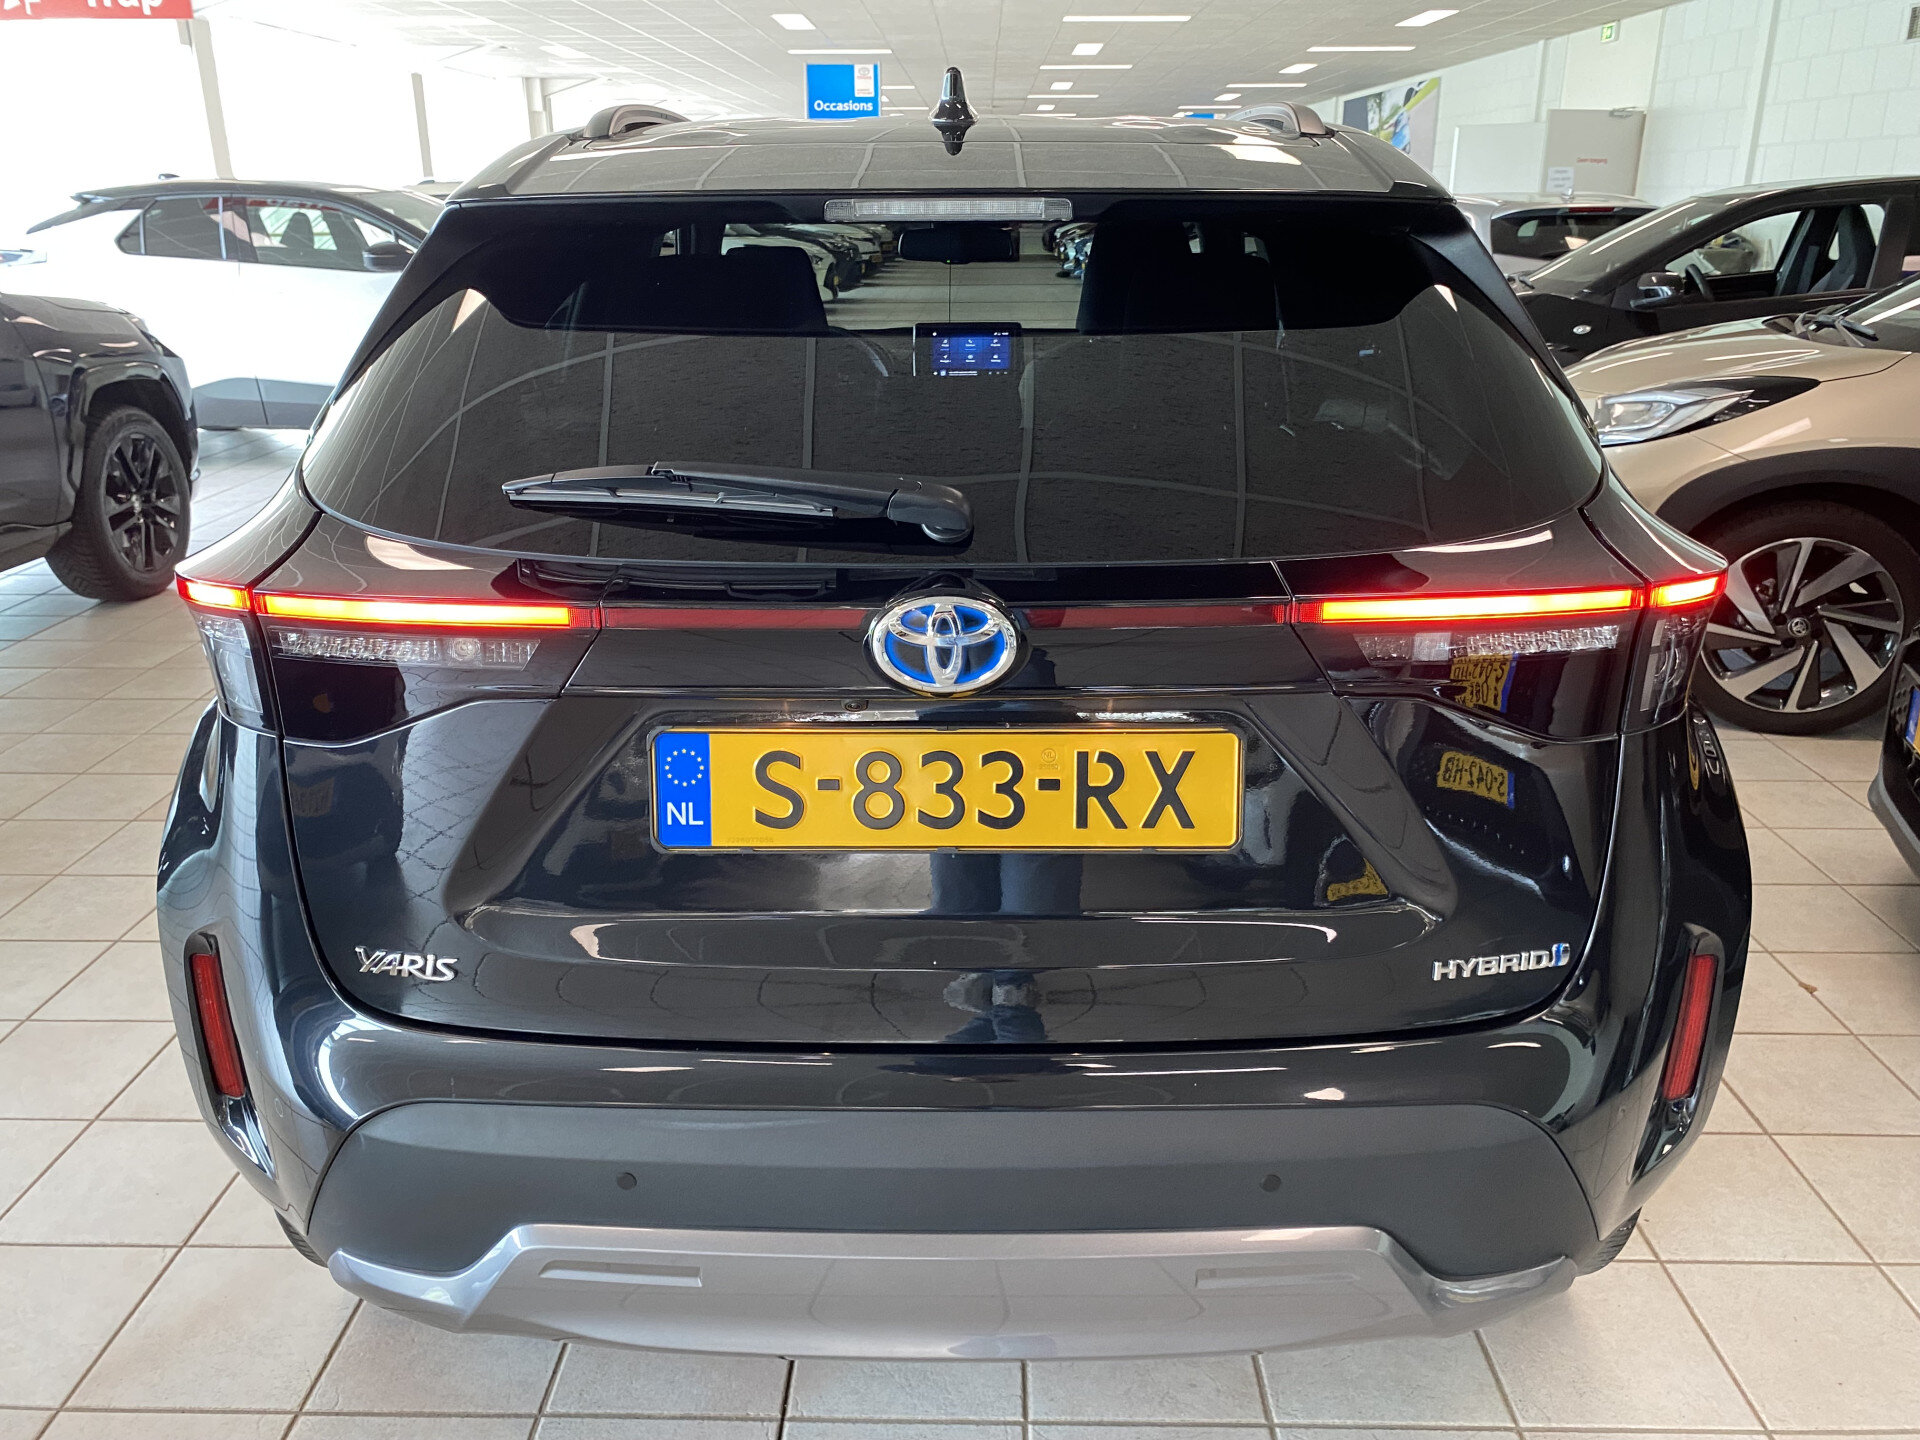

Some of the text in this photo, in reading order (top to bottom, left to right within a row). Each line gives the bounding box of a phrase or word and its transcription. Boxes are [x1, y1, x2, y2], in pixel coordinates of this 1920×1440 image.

[813, 100, 874, 112] Occasions
[753, 750, 1196, 829] S-833-RX
[666, 802, 704, 826] NL
[354, 946, 459, 982] YARIS
[1431, 950, 1550, 982] HYBRID
